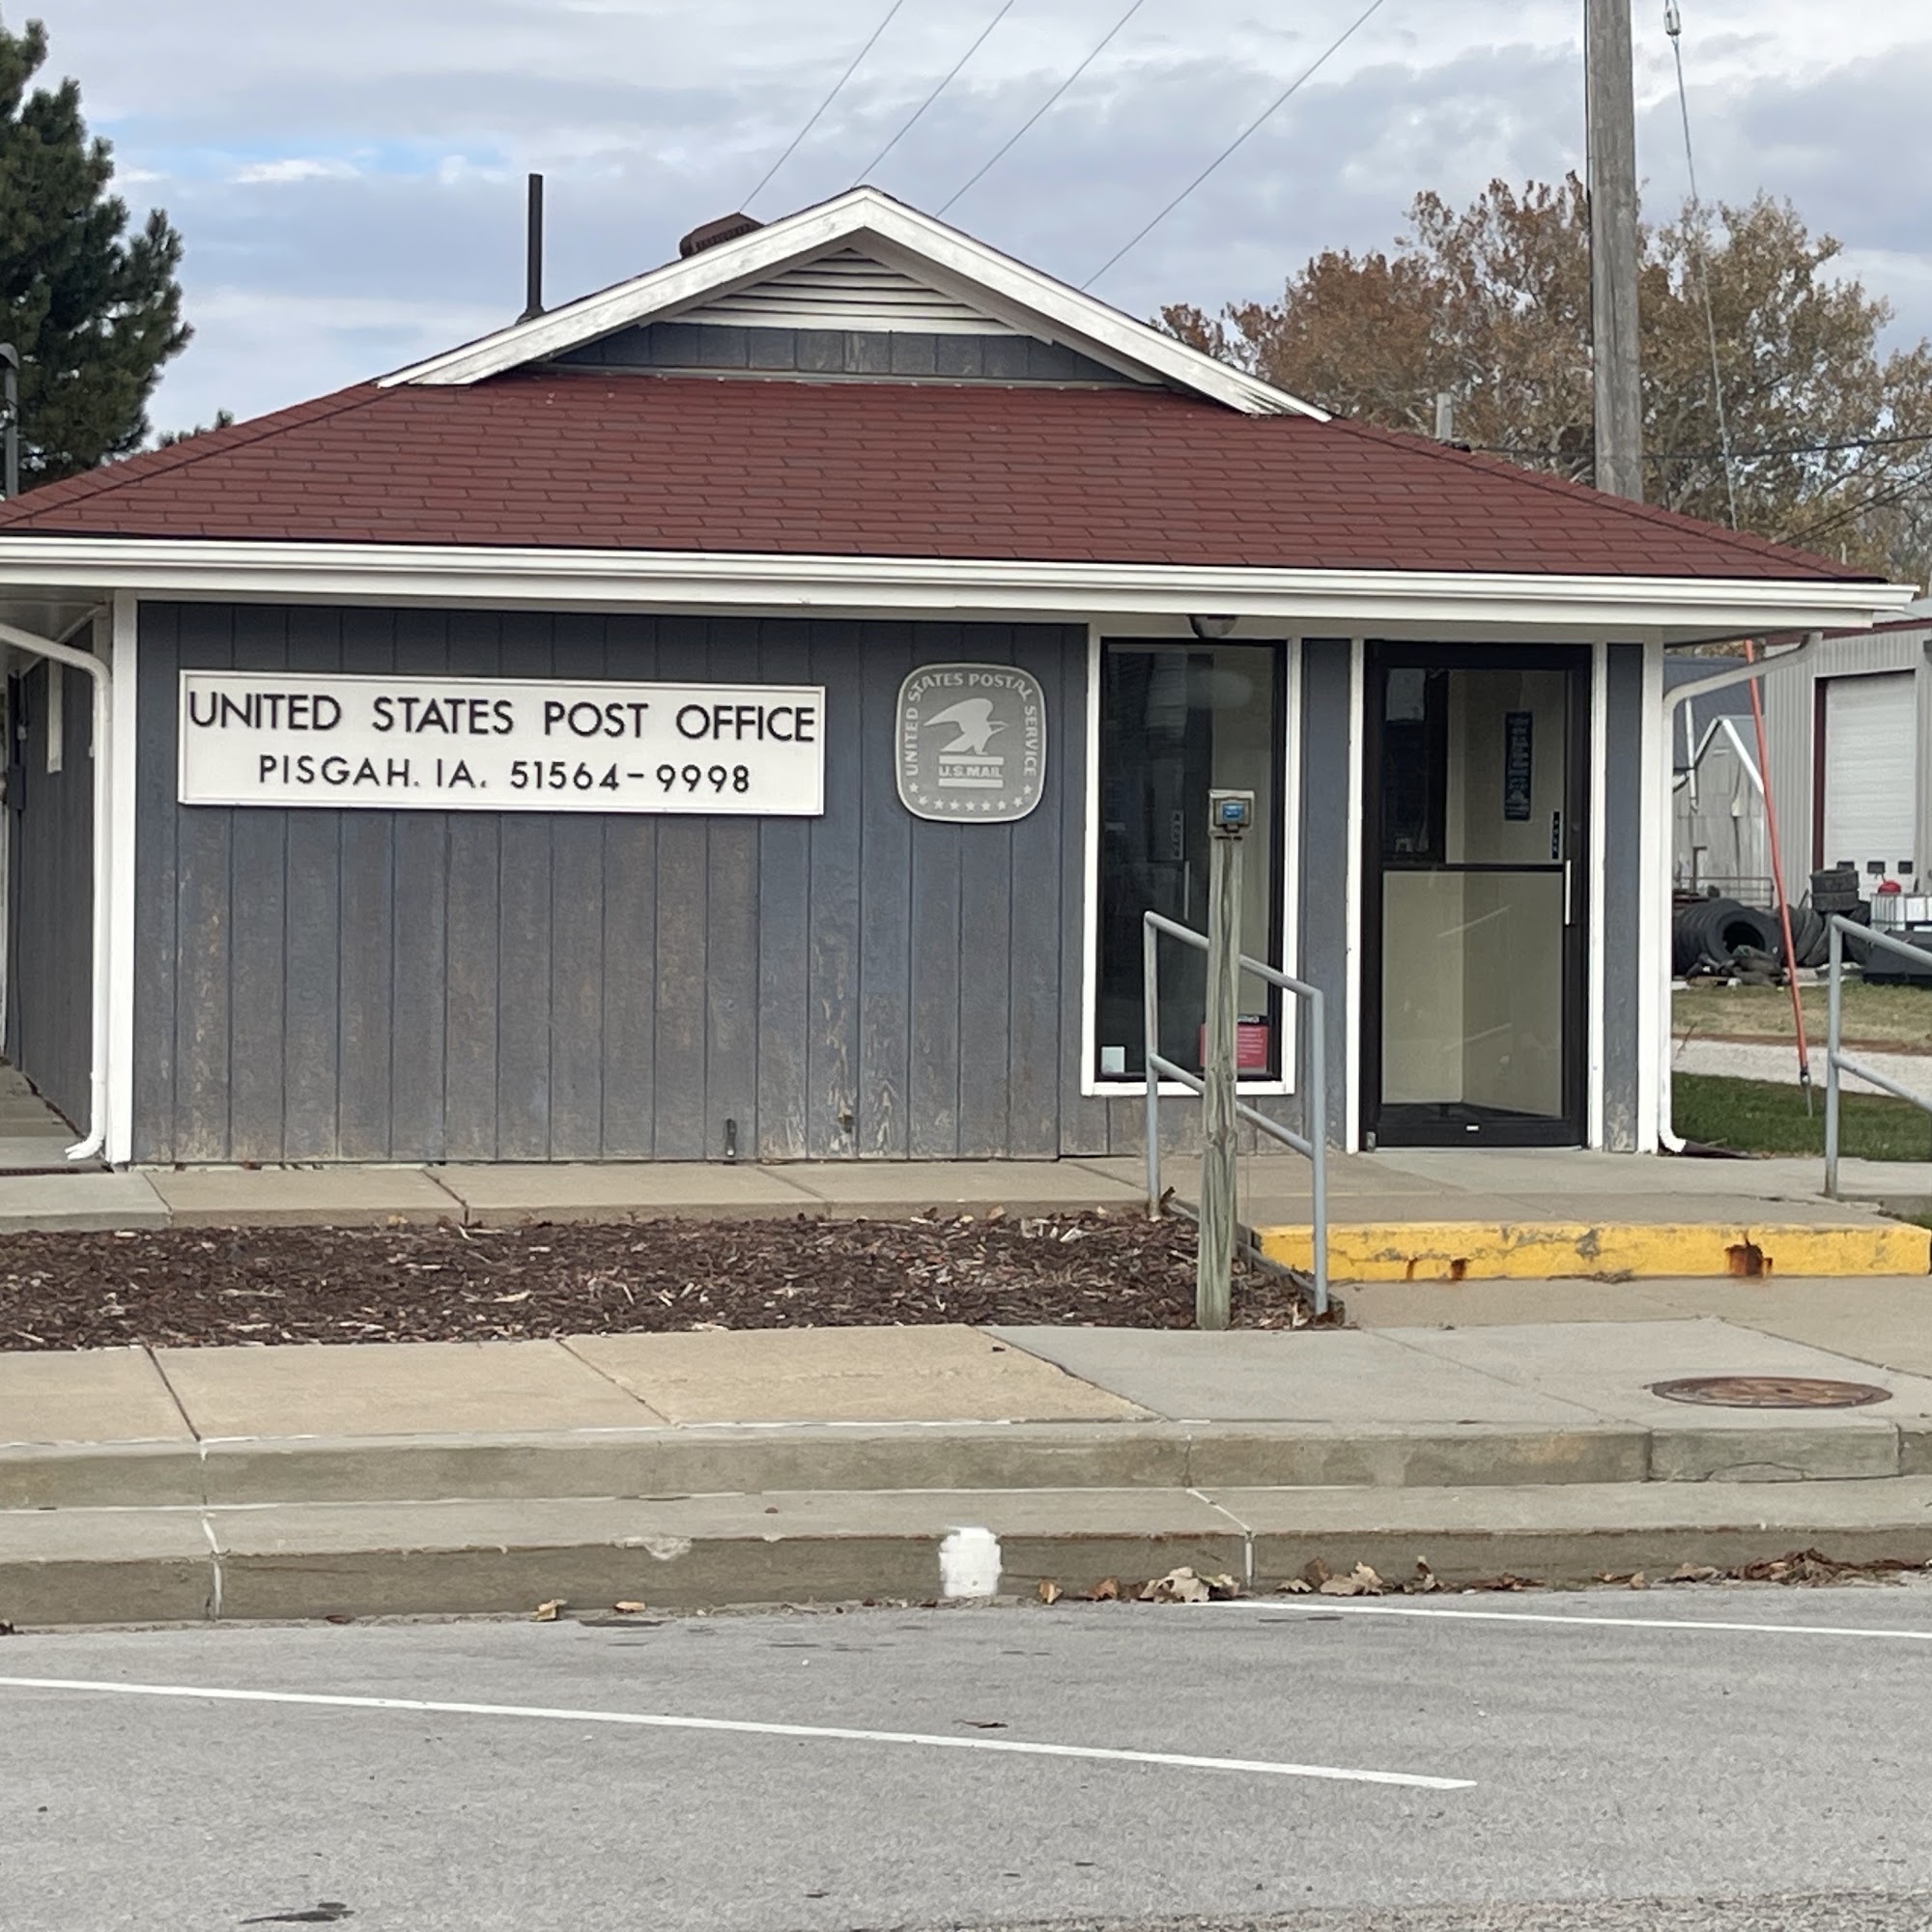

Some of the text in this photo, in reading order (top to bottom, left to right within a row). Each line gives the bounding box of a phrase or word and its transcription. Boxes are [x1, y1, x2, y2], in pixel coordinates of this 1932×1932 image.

[189, 691, 815, 743] UNITED STATES POST OFFICE
[905, 672, 1037, 777] UNITED STATES POSTAL SERVICE
